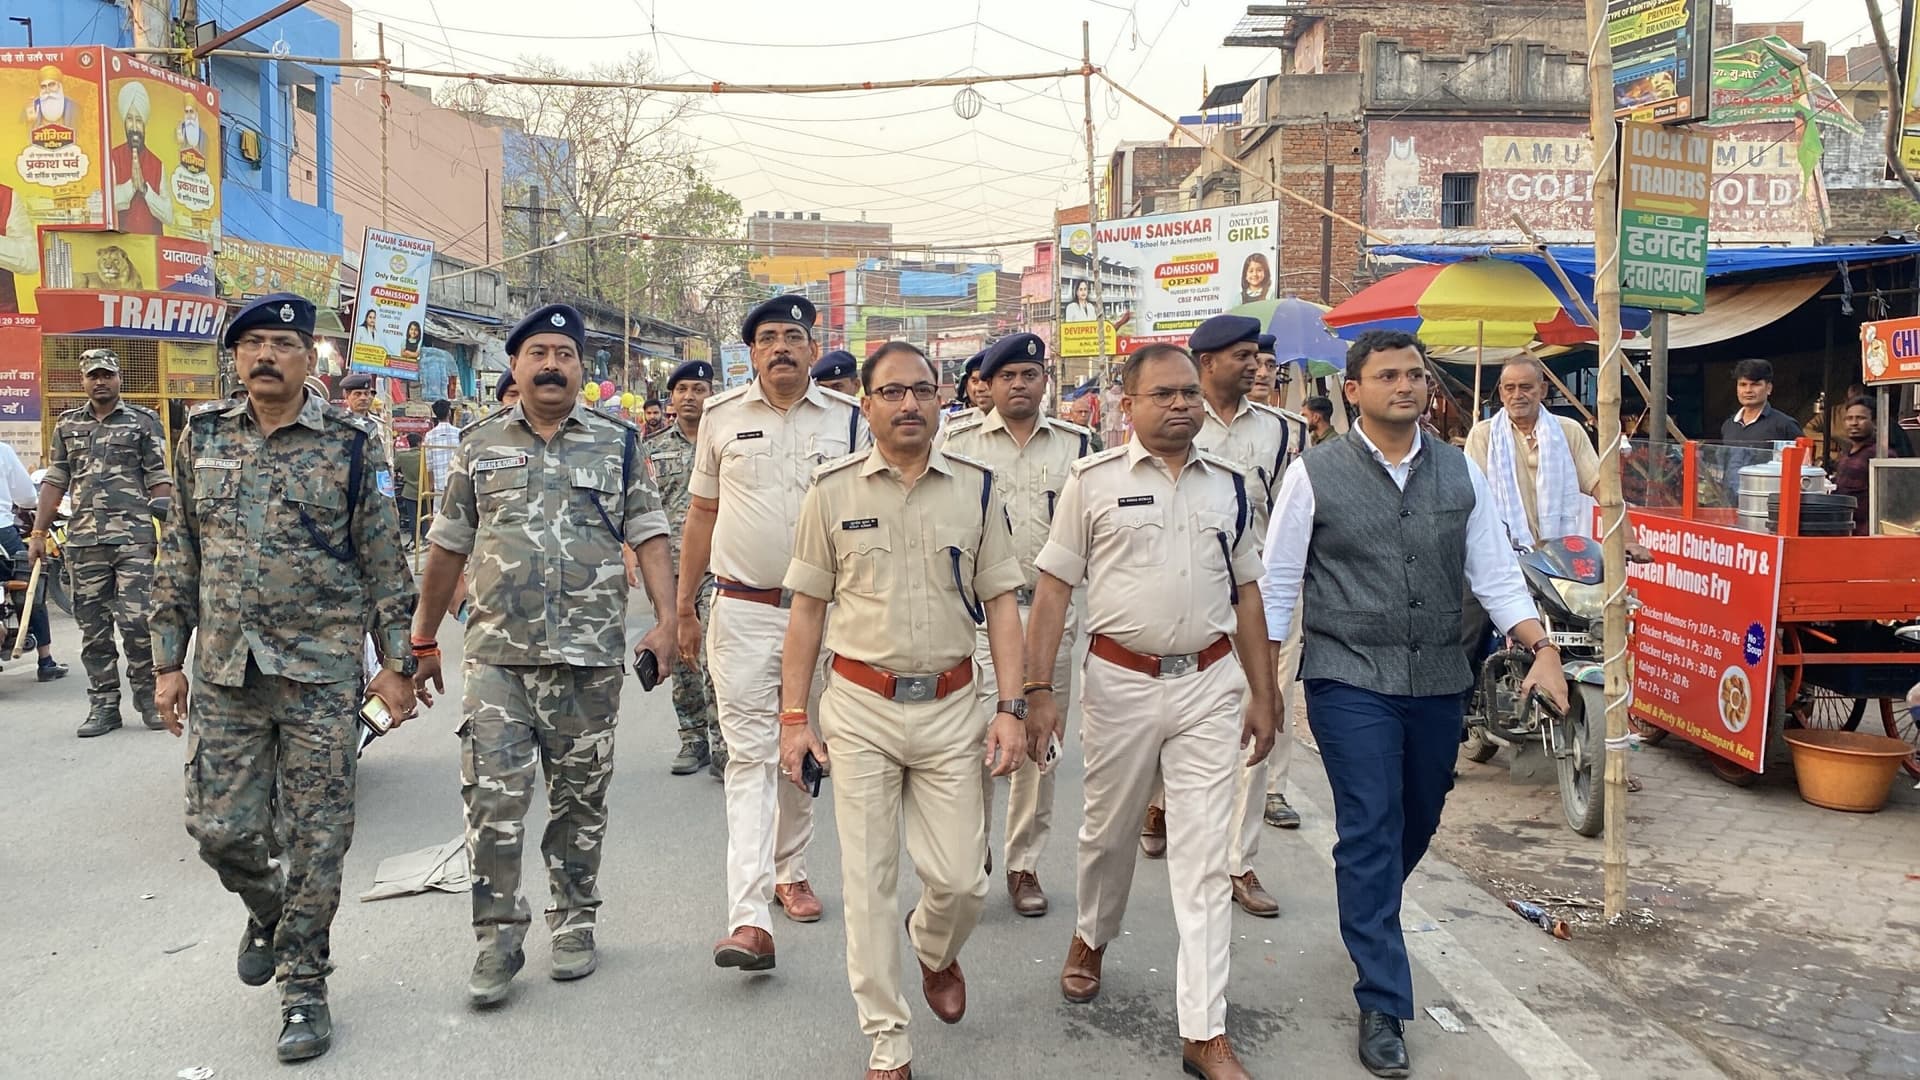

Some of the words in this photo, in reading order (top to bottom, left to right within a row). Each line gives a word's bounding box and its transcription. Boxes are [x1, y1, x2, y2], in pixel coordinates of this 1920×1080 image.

[1647, 4, 1680, 21] PRINTING
[1646, 18, 1680, 34] BRANDING
[1504, 142, 1580, 164] AMU
[1631, 127, 1684, 162] LOCK
[1687, 134, 1708, 166] IN
[26, 159, 59, 170] प्रकाश
[63, 156, 79, 168] पर्व
[1716, 145, 1792, 168] MUL
[177, 180, 197, 194] प्रकाश
[1630, 163, 1706, 200] TRADERS
[1718, 177, 1793, 206] OLD
[1096, 225, 1142, 244] ANJUM
[1145, 217, 1212, 239] SANSKAR
[1229, 217, 1251, 229] ONLY
[1252, 215, 1269, 226] FOR
[370, 233, 397, 245] ANJUM
[398, 239, 432, 252] SANSKAR
[1139, 240, 1159, 249] School
[1170, 235, 1212, 247] Achievements
[1227, 225, 1270, 243] GIRLS
[1625, 225, 1705, 262] हमदर्द
[162, 249, 201, 265] यातायात
[242, 243, 266, 264] TOYS
[277, 248, 296, 269] GIFT
[297, 252, 329, 273] CORNER
[375, 271, 388, 280] Only
[400, 277, 418, 285] GIRLS
[1160, 262, 1214, 276] ADMISSION
[1622, 259, 1704, 296] दवाखाना
[1168, 276, 1202, 286] OPEN
[375, 287, 416, 302] ADMISSION
[380, 299, 406, 308] OPEN
[1194, 294, 1219, 302] PATTERN
[98, 293, 214, 335] TRAFFIC
[1064, 326, 1097, 335] DEVIPRIY
[19, 371, 34, 380] का
[1639, 523, 1681, 556] Special
[1683, 531, 1734, 567] Chicken
[1736, 542, 1758, 575] Fry
[1758, 551, 1769, 575] &
[1627, 560, 1664, 585] hicken
[1666, 561, 1709, 597] Momos
[1710, 572, 1731, 605] Fry
[1641, 605, 1663, 621] Chicken
[1664, 611, 1687, 628] Momos
[1688, 619, 1698, 634] Fry
[1699, 622, 1708, 635] 10
[1708, 625, 1716, 638] Ps
[1722, 629, 1731, 642] 70
[1731, 632, 1740, 646] Rs
[1641, 623, 1662, 640] Chicken
[1691, 639, 1699, 653] Ps
[1703, 644, 1713, 657] 20
[1713, 647, 1722, 660] Rs
[1747, 633, 1757, 644] No
[1640, 641, 1661, 658] Chicken
[1662, 648, 1673, 665] Leg
[1673, 653, 1680, 665] Ps
[1686, 658, 1694, 671] Ps
[1698, 662, 1708, 675] 30
[1708, 666, 1717, 679] Rs
[1747, 643, 1762, 658] Soup
[1661, 668, 1669, 680] Ps
[1672, 672, 1681, 685] 20
[1681, 675, 1690, 688] Rs
[1653, 683, 1660, 696] Ps
[1663, 688, 1672, 701] 25
[1672, 691, 1680, 704] Rs
[1633, 698, 1652, 714] Shadi
[1658, 708, 1675, 727] Party
[1701, 728, 1735, 753] Sampark
[1736, 743, 1755, 761] Kare
